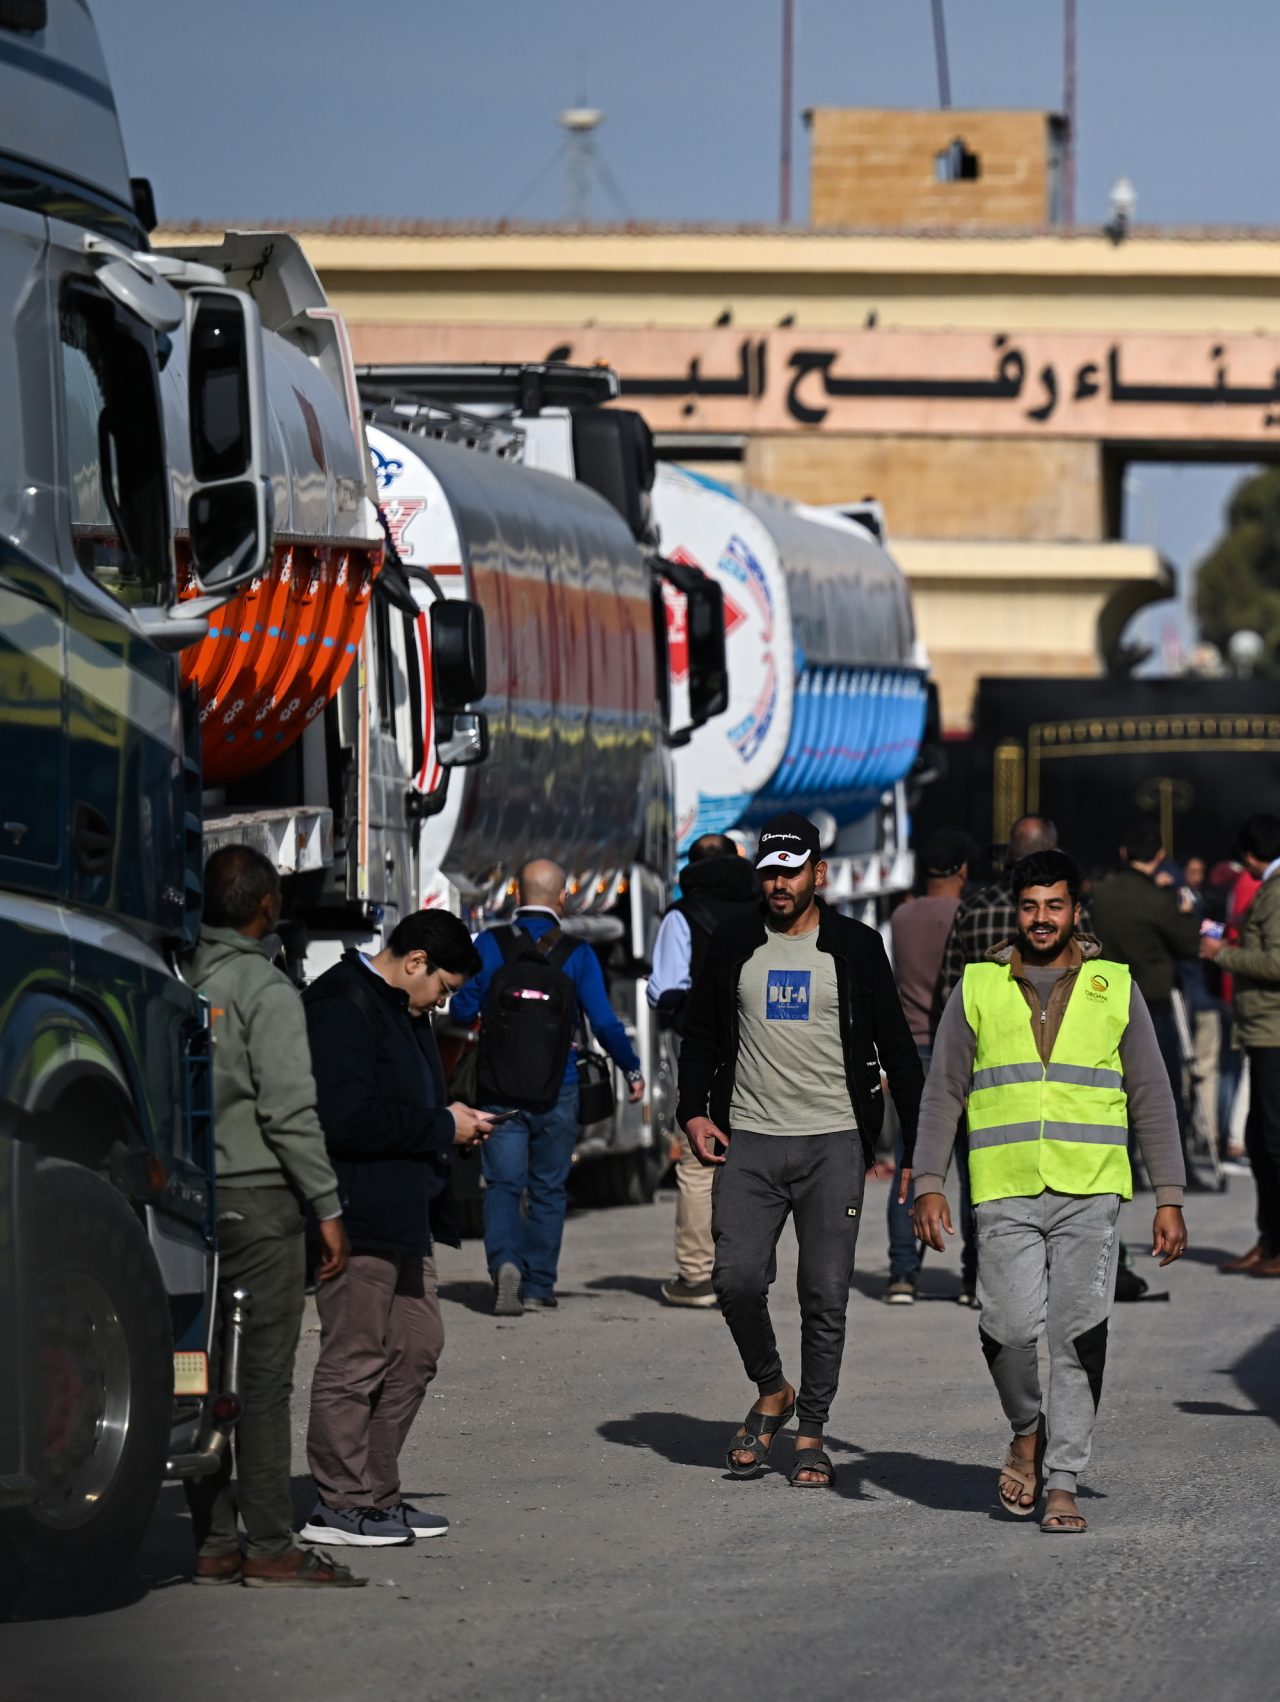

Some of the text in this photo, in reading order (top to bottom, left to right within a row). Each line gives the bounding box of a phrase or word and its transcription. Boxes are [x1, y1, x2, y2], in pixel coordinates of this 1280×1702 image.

[546, 336, 768, 417] الب
[787, 333, 1058, 425] رفح
[762, 833, 801, 842] Champion
